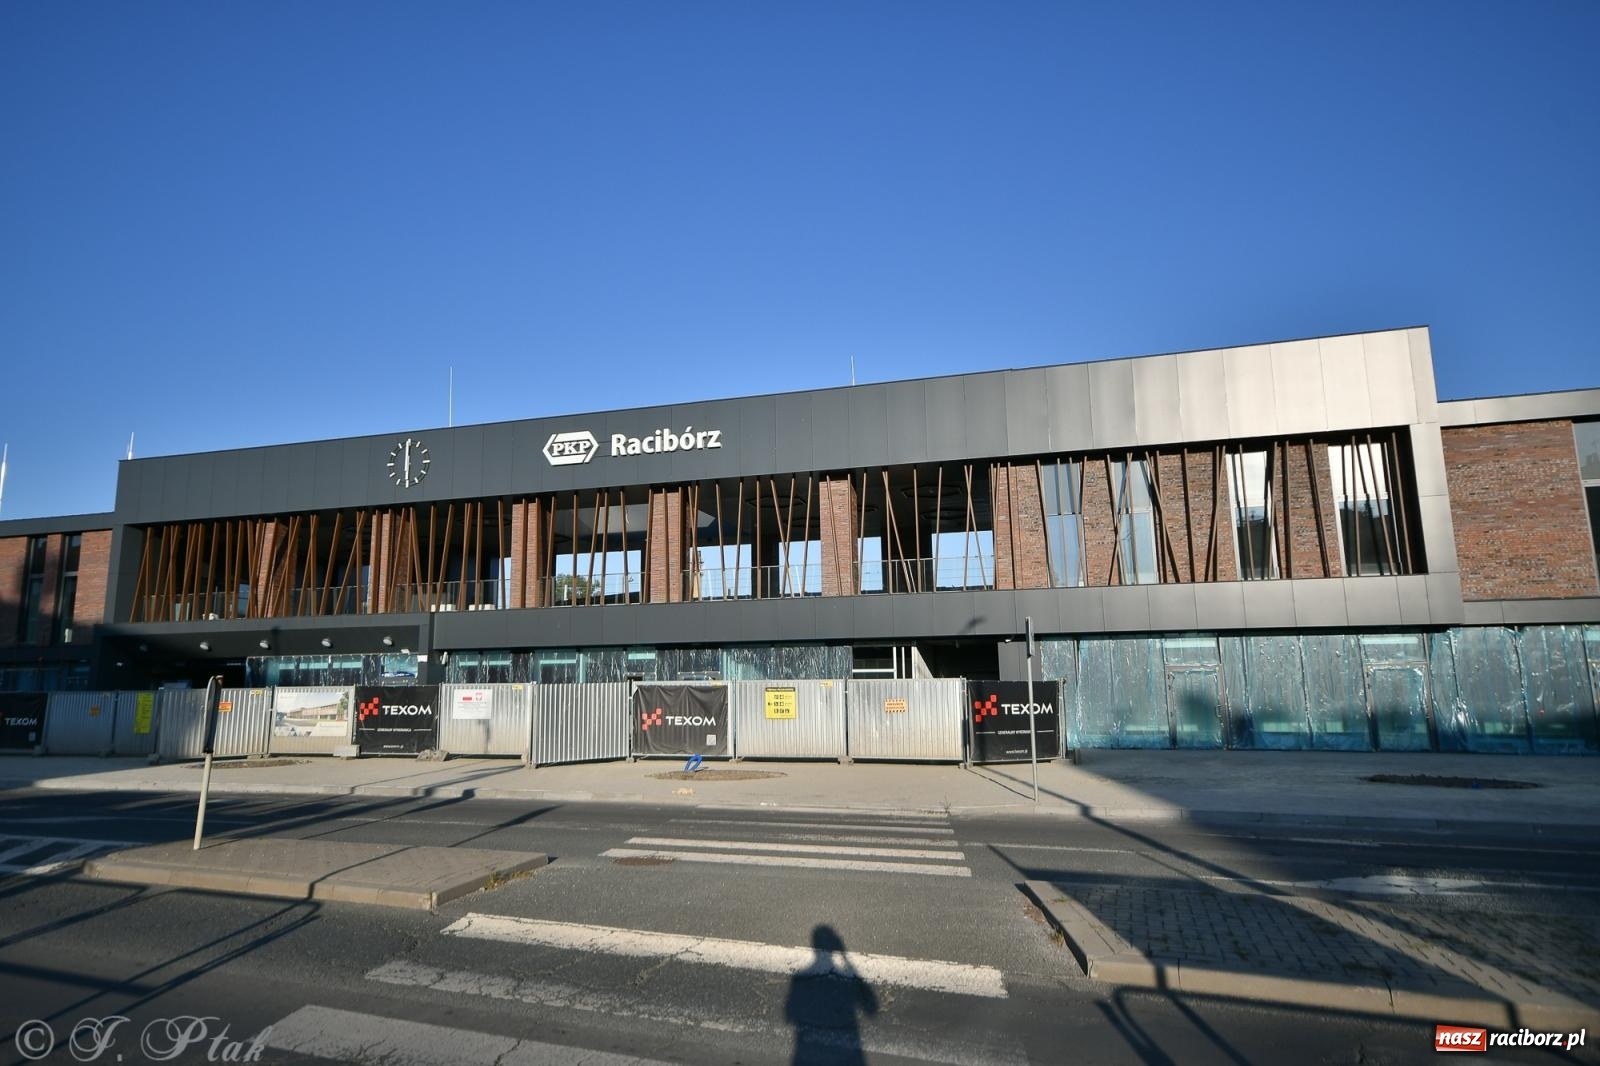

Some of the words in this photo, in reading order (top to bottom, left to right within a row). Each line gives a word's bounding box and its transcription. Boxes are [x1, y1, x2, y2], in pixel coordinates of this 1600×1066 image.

[552, 441, 592, 457] PKP
[611, 426, 722, 457] Racibórz
[382, 704, 433, 716] TEXOM
[1001, 703, 1054, 715] TEXOM
[4, 717, 38, 726] TEXOM
[665, 716, 717, 726] TEXOM
